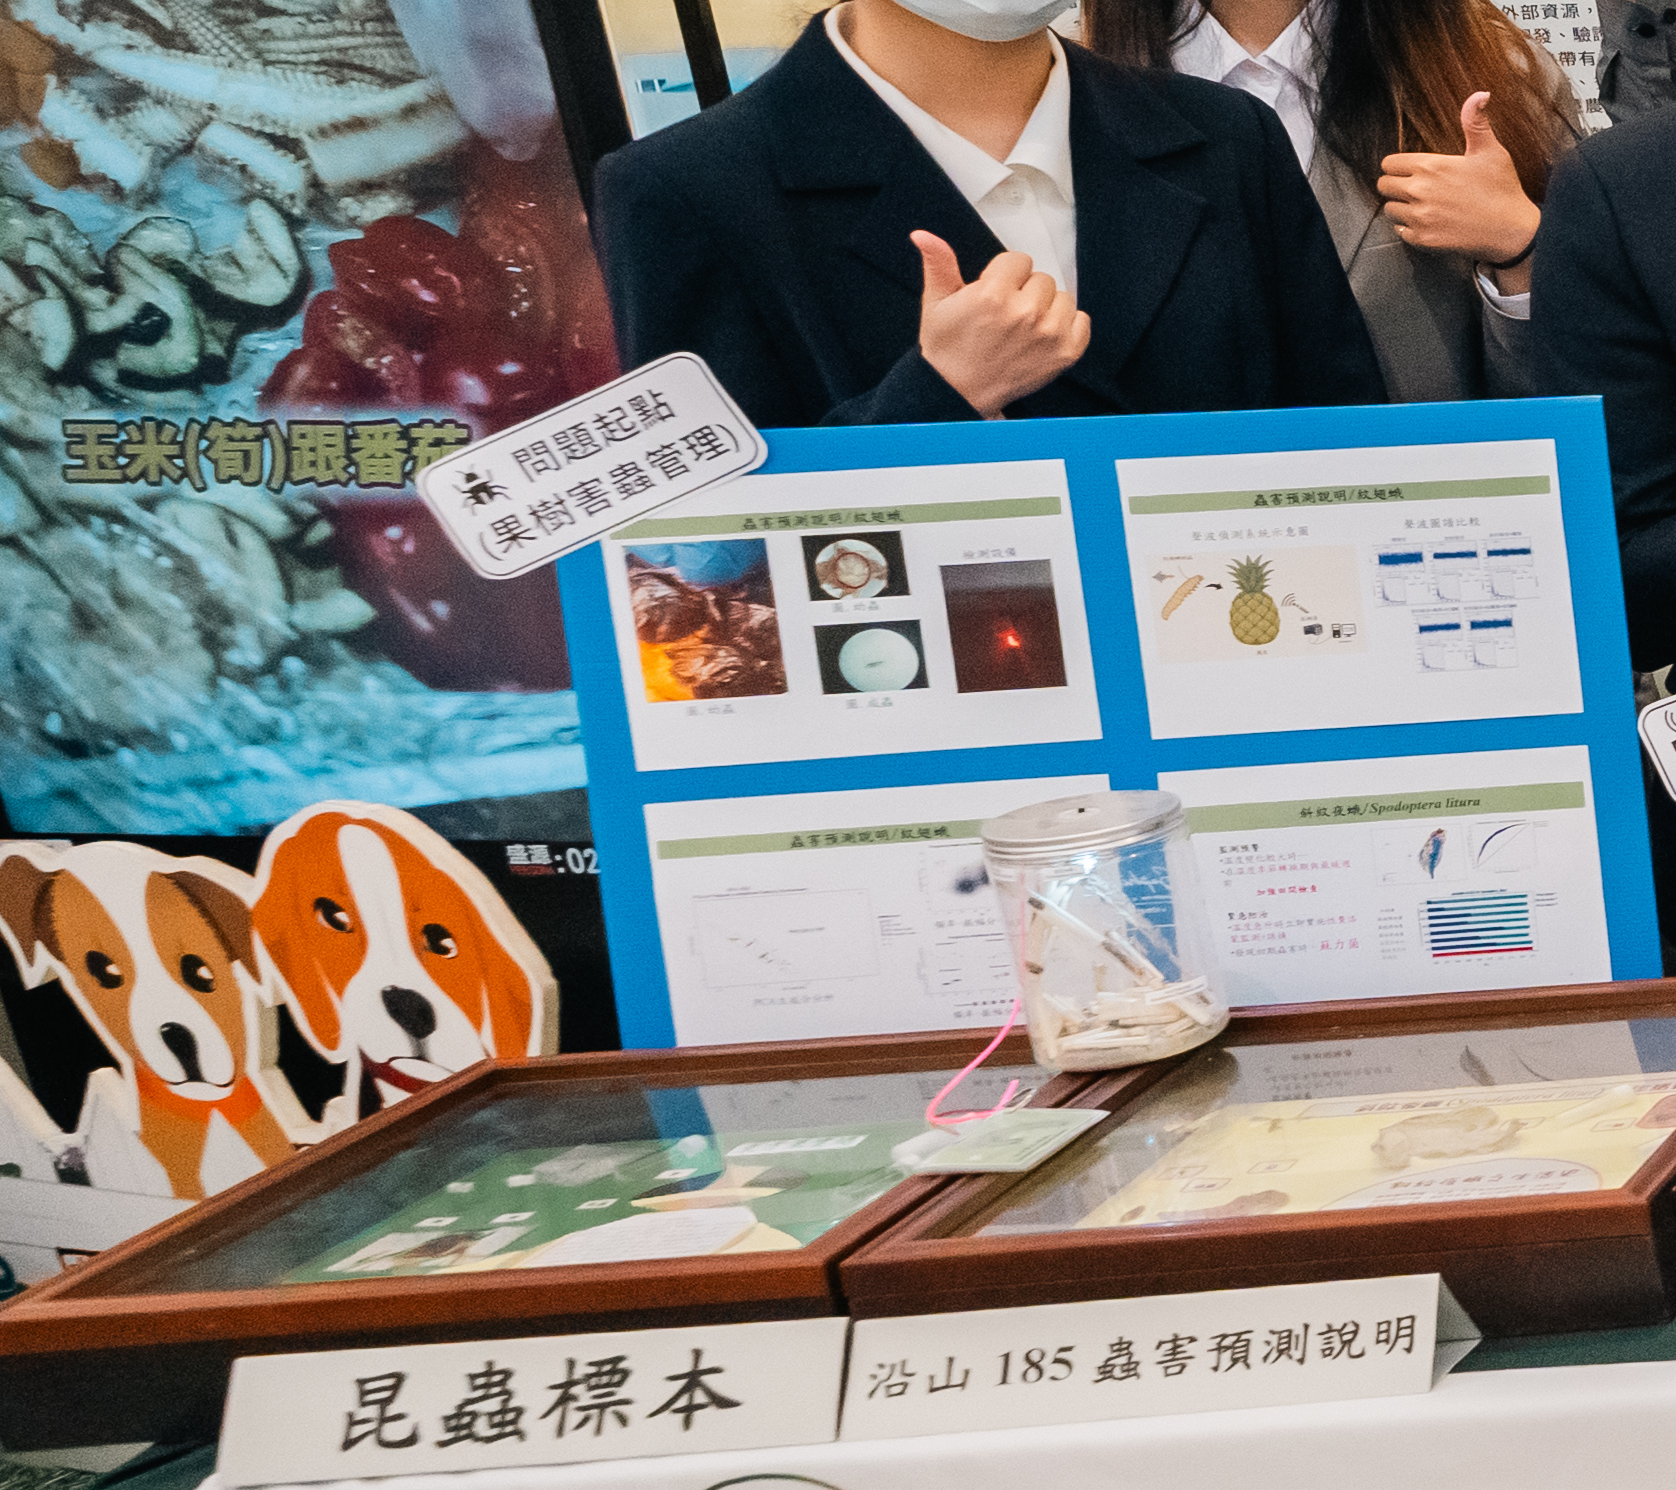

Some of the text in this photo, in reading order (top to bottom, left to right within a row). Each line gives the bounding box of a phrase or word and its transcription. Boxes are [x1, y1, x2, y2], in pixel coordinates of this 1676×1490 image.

[511, 389, 675, 483] 問題起點
[477, 422, 741, 563] (果樹害蟲管理)
[1445, 797, 1481, 808] litura
[337, 1347, 742, 1454] 昆蟲標本
[866, 1313, 1419, 1400] 沿山 185 蟲害預測說明
